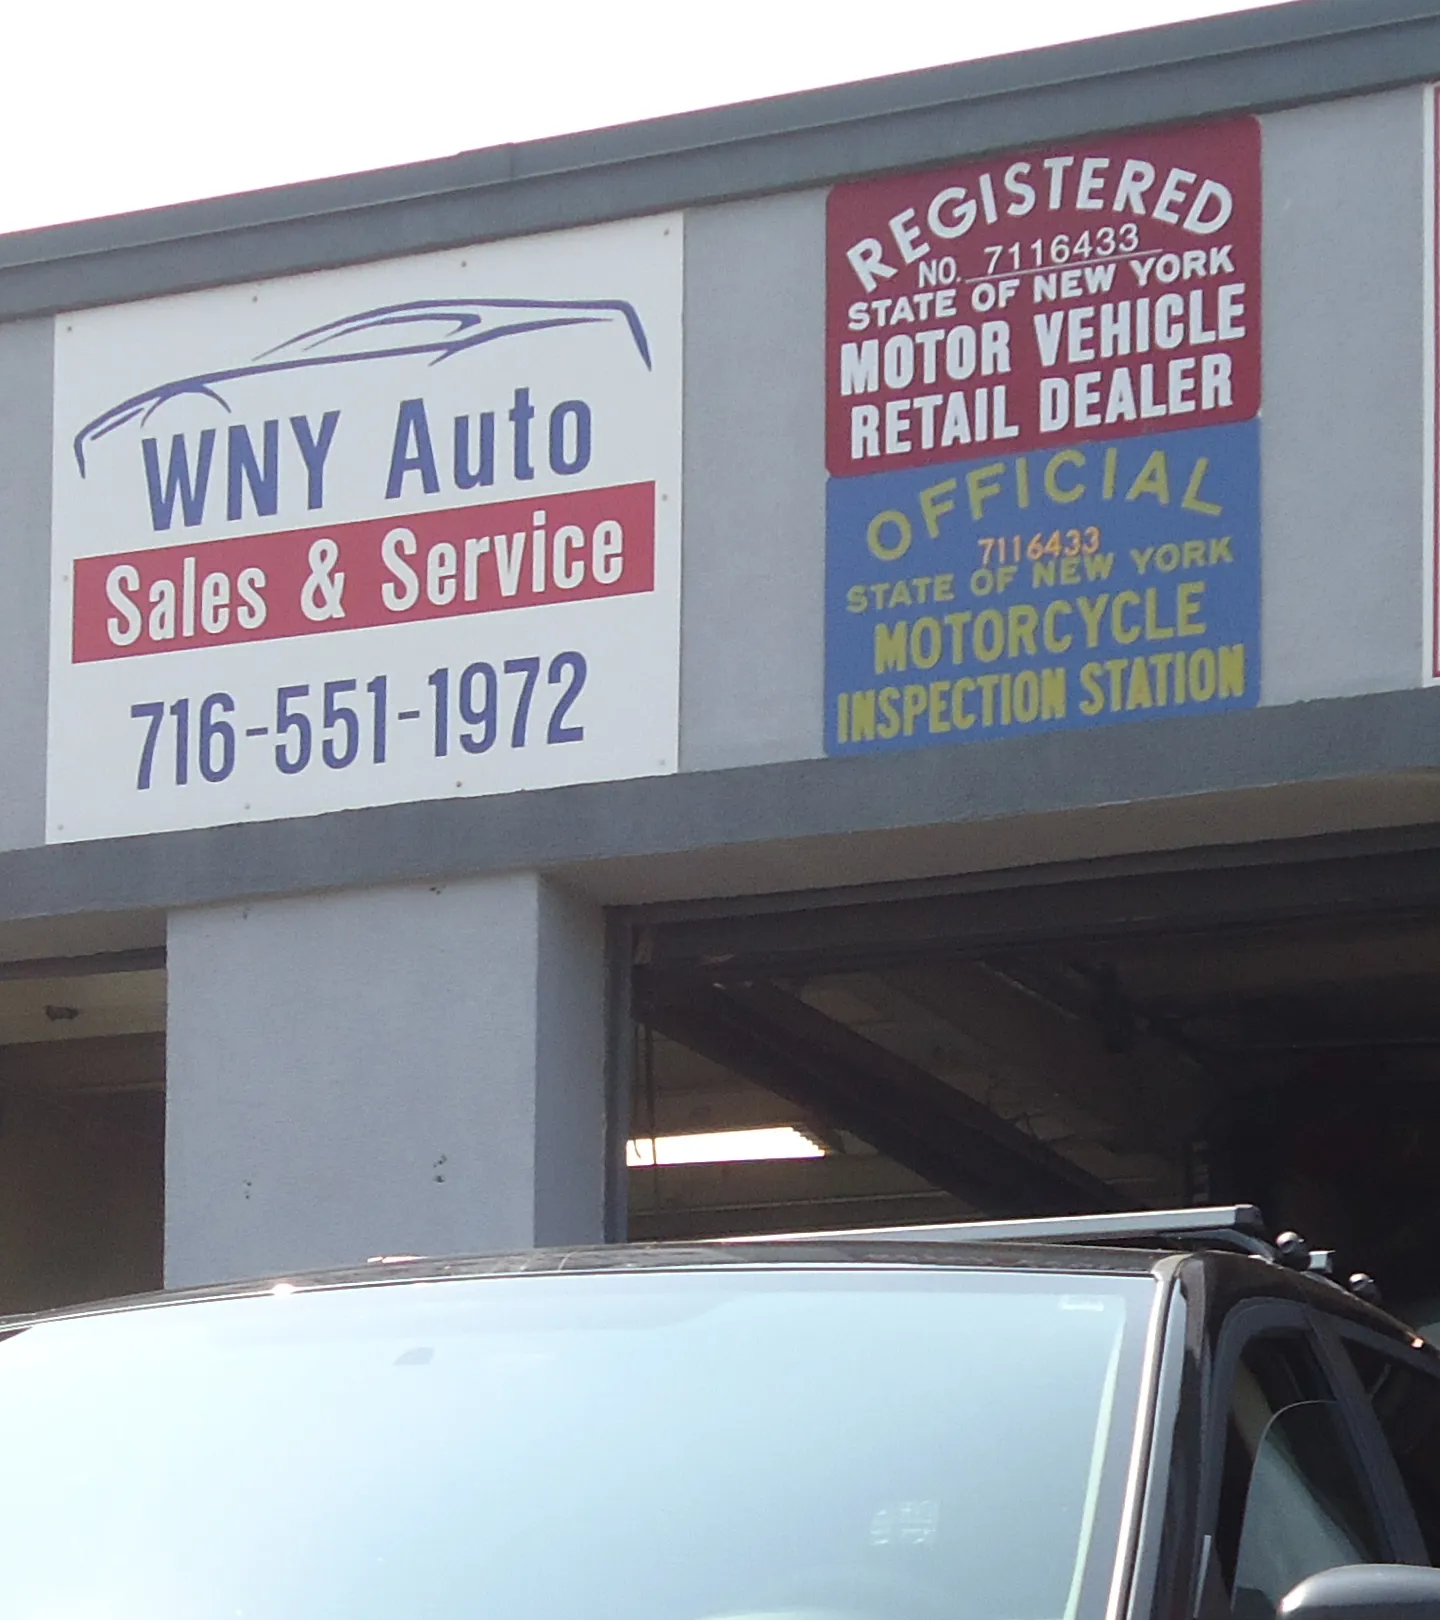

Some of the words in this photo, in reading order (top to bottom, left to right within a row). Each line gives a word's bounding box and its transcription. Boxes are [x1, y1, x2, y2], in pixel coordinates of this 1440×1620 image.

[846, 156, 1233, 293] REGISTERED
[918, 256, 962, 287] NO.
[983, 223, 1140, 275] 7116433
[840, 319, 1011, 398] MOTOR
[1034, 283, 1246, 369] VEHICLE
[848, 290, 957, 331] STATE
[971, 279, 1019, 313] OF
[1033, 267, 1115, 303] NEW
[1130, 245, 1235, 288] YORK
[142, 410, 341, 531] WNY
[385, 387, 591, 500] Auto
[850, 385, 1019, 460] RETAIL
[1039, 353, 1234, 436] DEALER
[866, 448, 1223, 561] OFFICIAL
[977, 527, 1101, 565] 7116433
[105, 557, 267, 646] Sales
[301, 538, 345, 621] &
[381, 511, 624, 612] Service
[847, 578, 954, 614] STATE
[970, 567, 1018, 598] OF
[1032, 552, 1113, 589] NEW
[1129, 536, 1235, 577] YORK
[874, 581, 1206, 676] MOTORCYCLE
[130, 650, 588, 790] 716-551-1972
[837, 667, 1066, 744] INSPECTION
[1079, 644, 1245, 716] STATION
